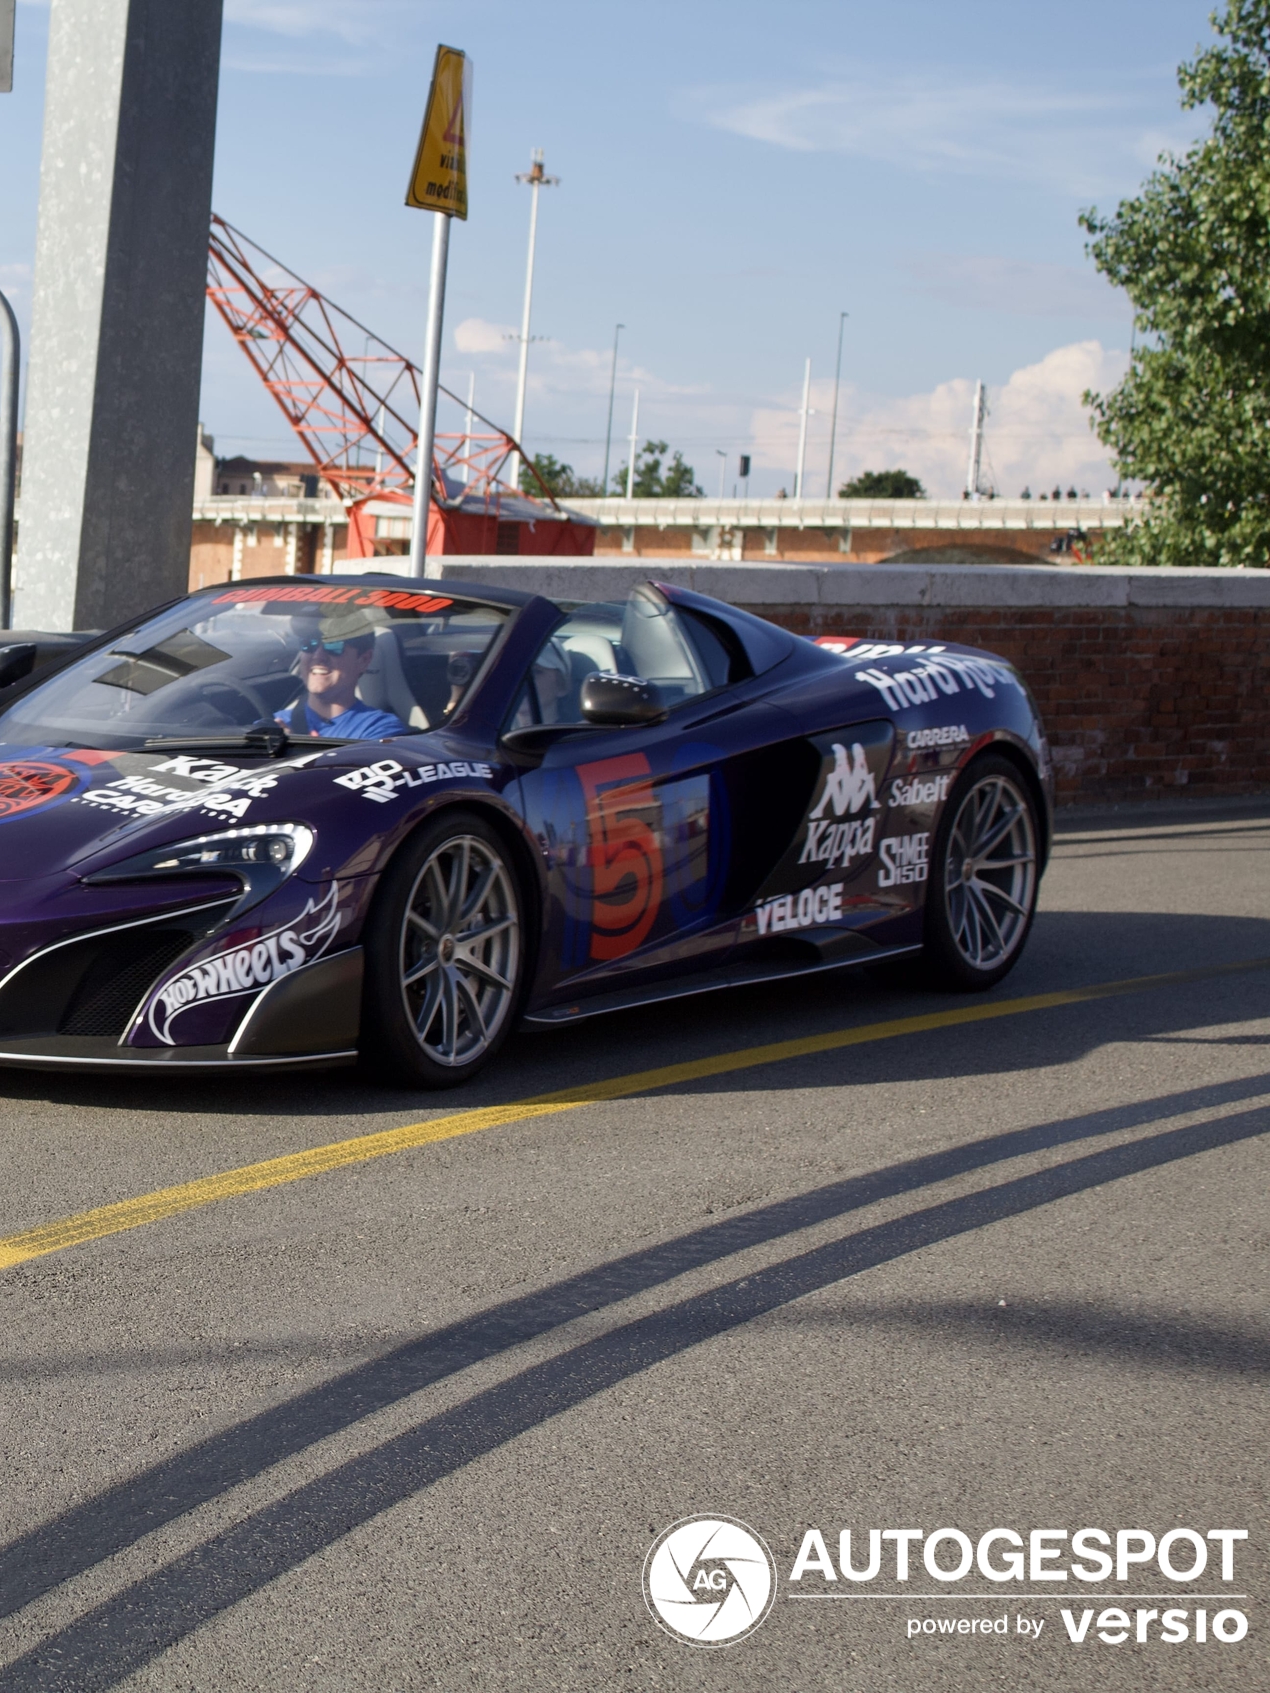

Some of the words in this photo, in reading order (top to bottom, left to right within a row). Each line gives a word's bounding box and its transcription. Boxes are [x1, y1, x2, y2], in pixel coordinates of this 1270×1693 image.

[212, 587, 363, 605] GUMBALL
[354, 590, 454, 612] 3000
[855, 657, 960, 711] Hard
[907, 725, 969, 750] CARRERA
[81, 789, 252, 818] CARRA
[888, 775, 950, 807] Sabelt
[797, 816, 876, 869] Kappa
[895, 863, 929, 885] 150
[754, 883, 844, 934] VELOCE
